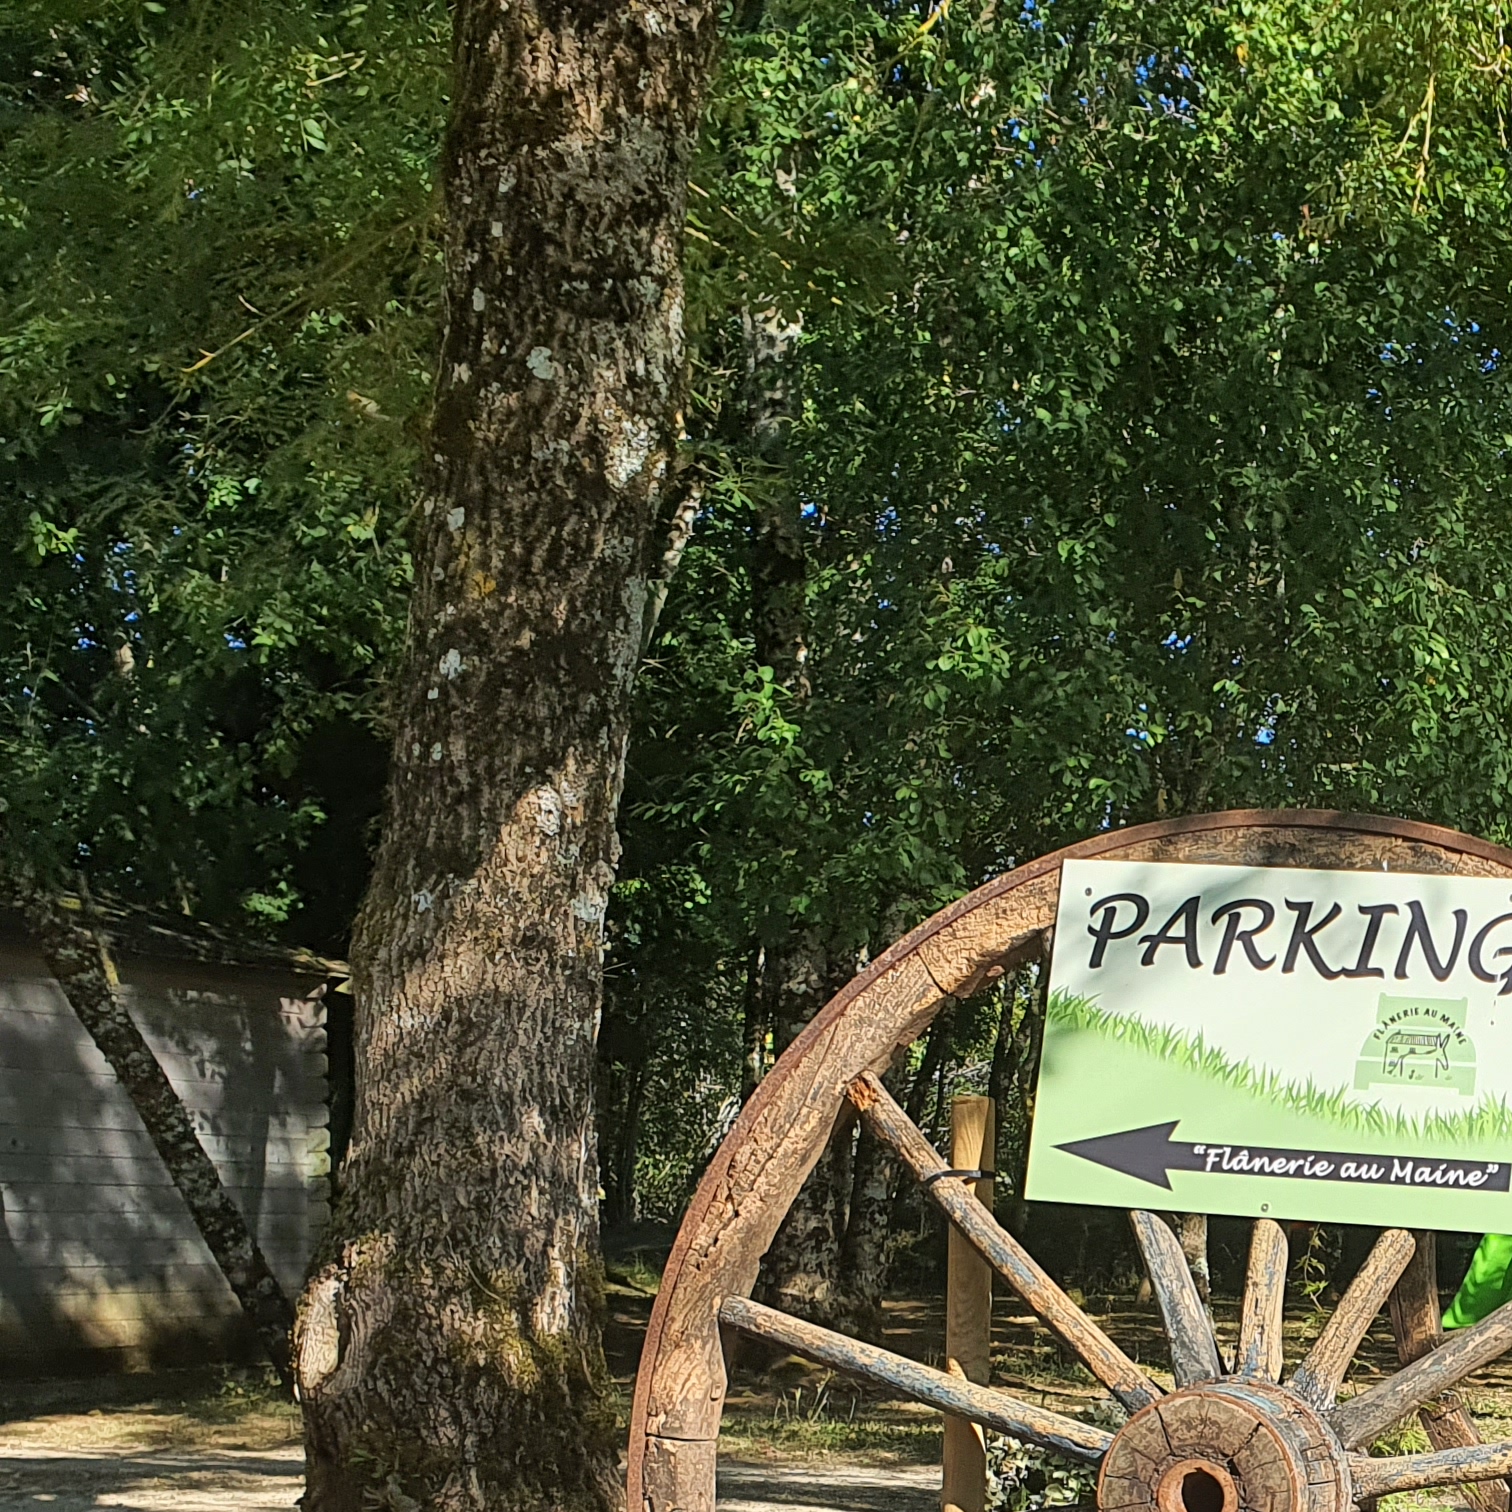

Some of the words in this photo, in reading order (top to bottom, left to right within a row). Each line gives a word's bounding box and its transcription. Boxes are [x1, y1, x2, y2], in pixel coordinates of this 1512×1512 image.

[1423, 1007, 1438, 1019] AU
[1440, 1013, 1467, 1046] MAINE
[1340, 1162, 1385, 1180] au
